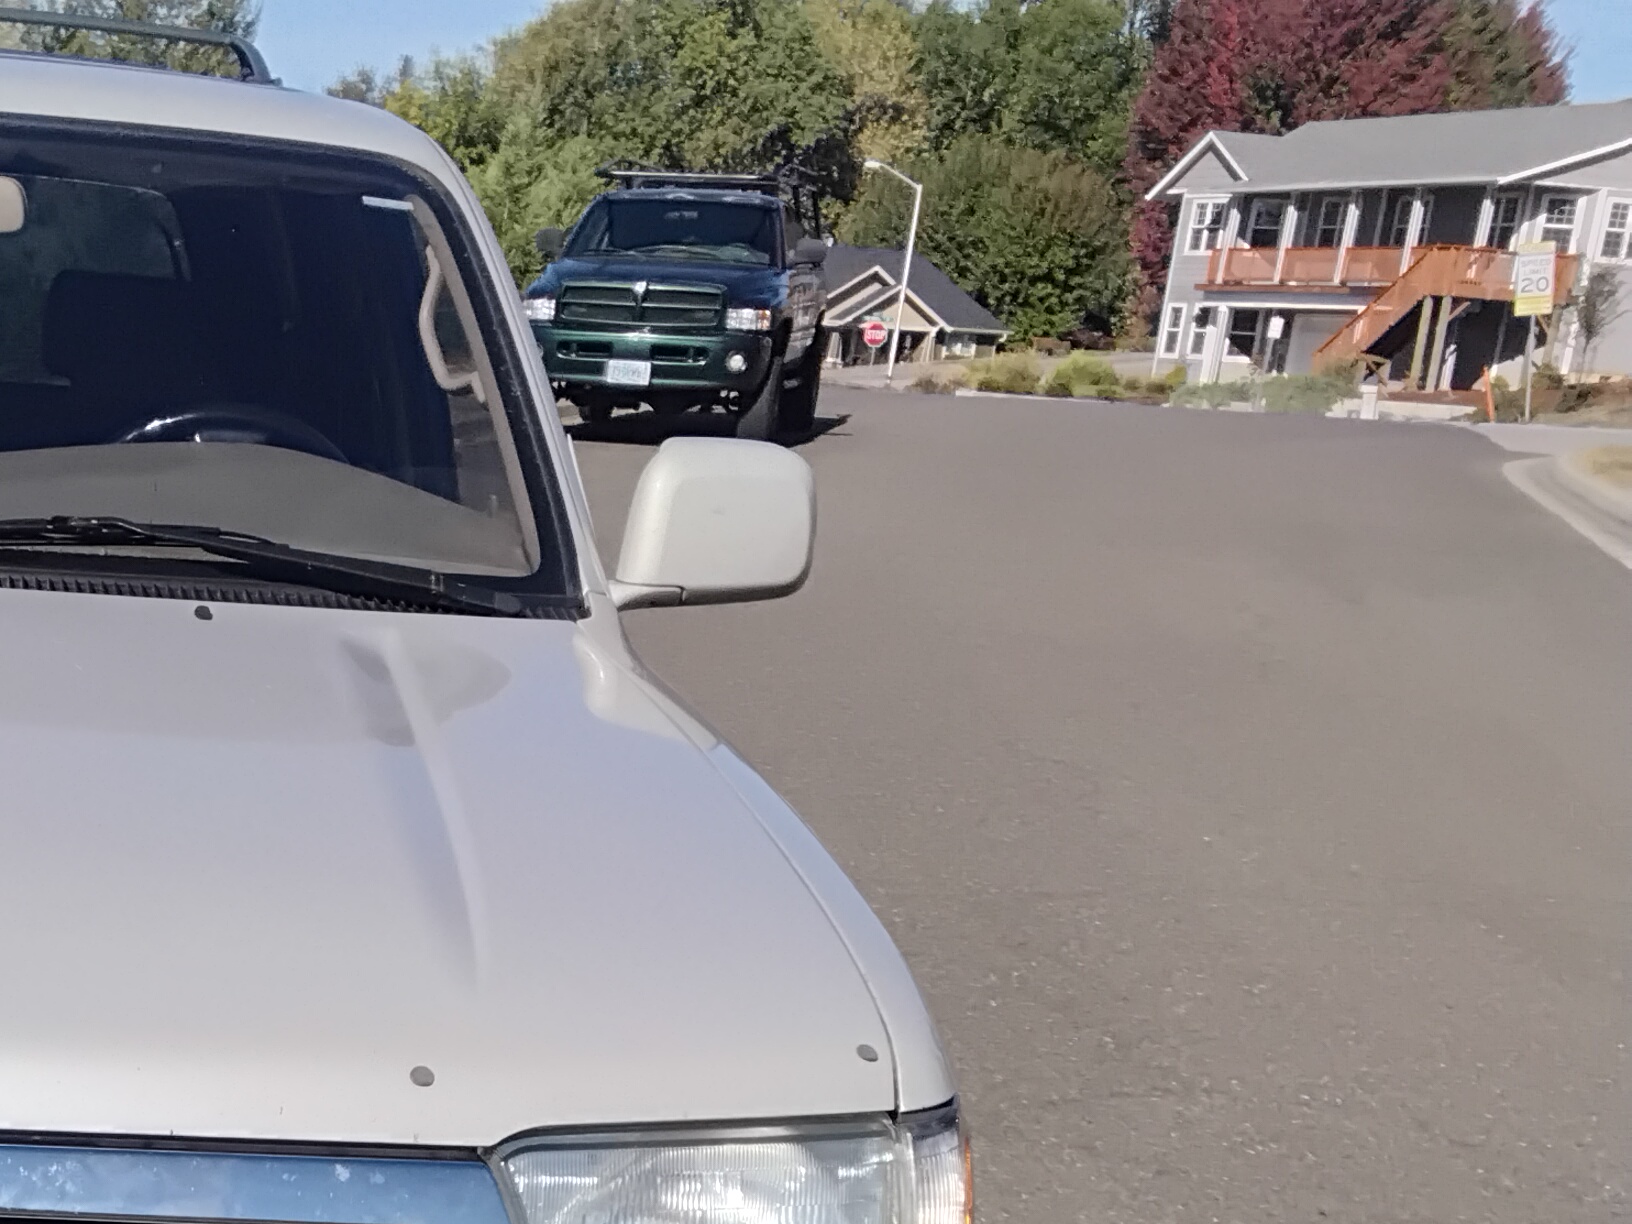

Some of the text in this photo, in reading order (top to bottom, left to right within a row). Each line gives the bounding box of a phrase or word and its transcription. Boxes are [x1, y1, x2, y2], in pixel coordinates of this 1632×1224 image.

[1521, 259, 1552, 267] SPEED
[1524, 267, 1546, 275] LIMIT
[1520, 276, 1550, 293] 20
[867, 330, 886, 340] STOP
